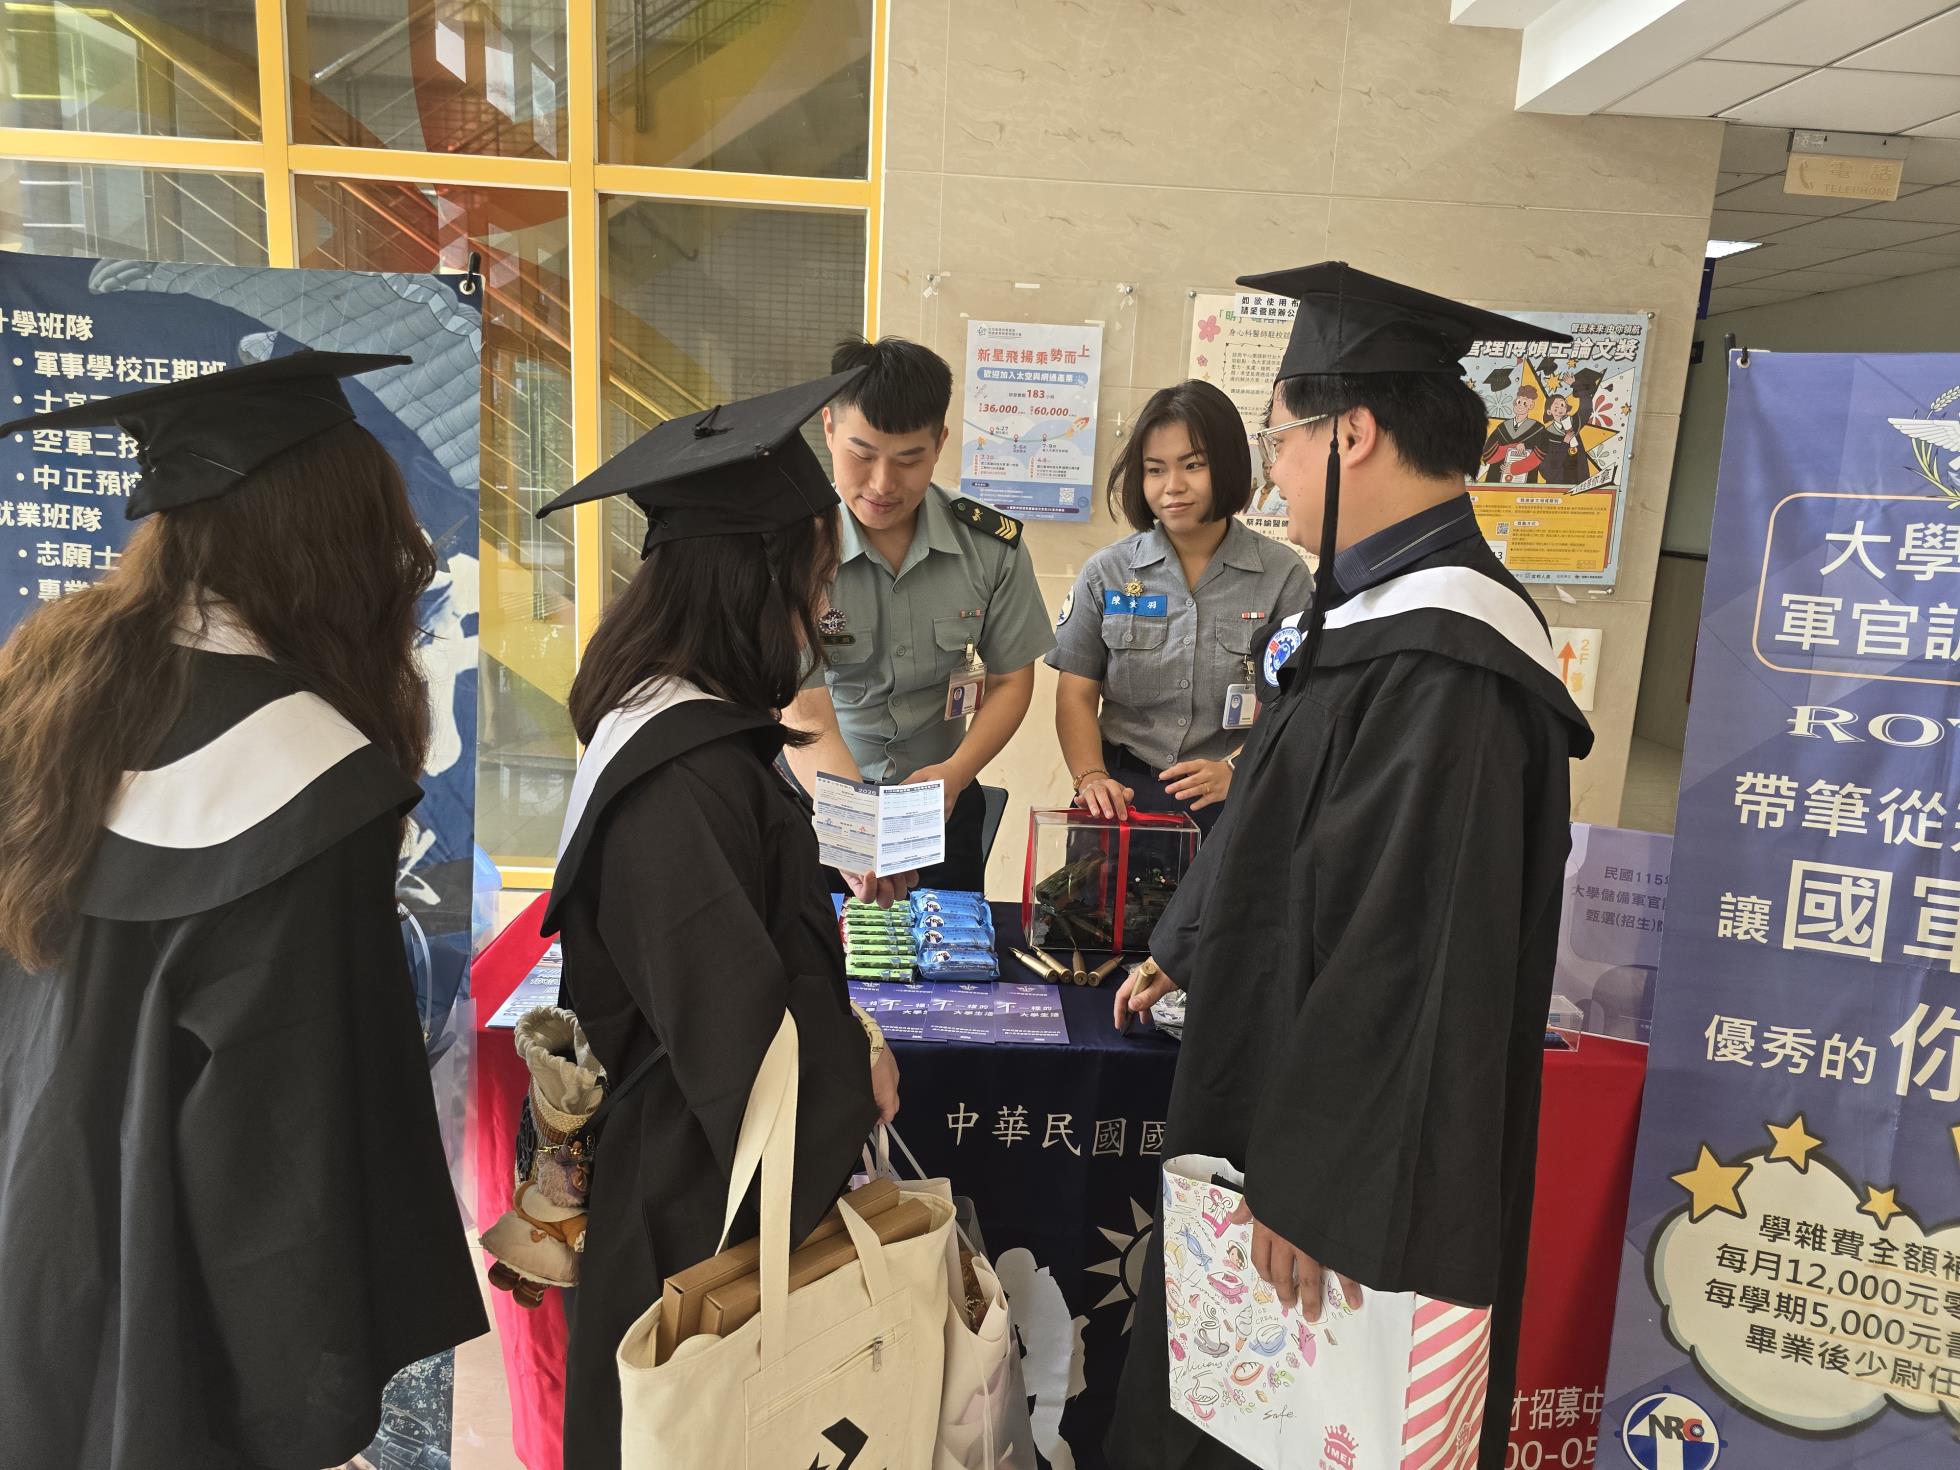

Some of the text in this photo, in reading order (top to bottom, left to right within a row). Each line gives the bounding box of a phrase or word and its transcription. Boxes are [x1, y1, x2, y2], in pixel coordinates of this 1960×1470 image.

[1824, 184, 1894, 197] TELEPHONE
[977, 344, 1091, 364] 新星飛揚乘勢而上
[34, 389, 112, 415] 士官
[1026, 389, 1045, 399] 183
[983, 403, 1018, 414] 36,000
[1034, 406, 1069, 417] 60,000
[1820, 520, 1960, 582] 大學
[1787, 705, 1960, 748] RO
[1735, 772, 1960, 853] 帶筆從
[1572, 885, 1665, 911] 大學儲備軍官
[1705, 1003, 1960, 1102] 優秀的你
[1649, 1414, 1703, 1441] NRC
[1326, 1444, 1353, 1466] IMEI
